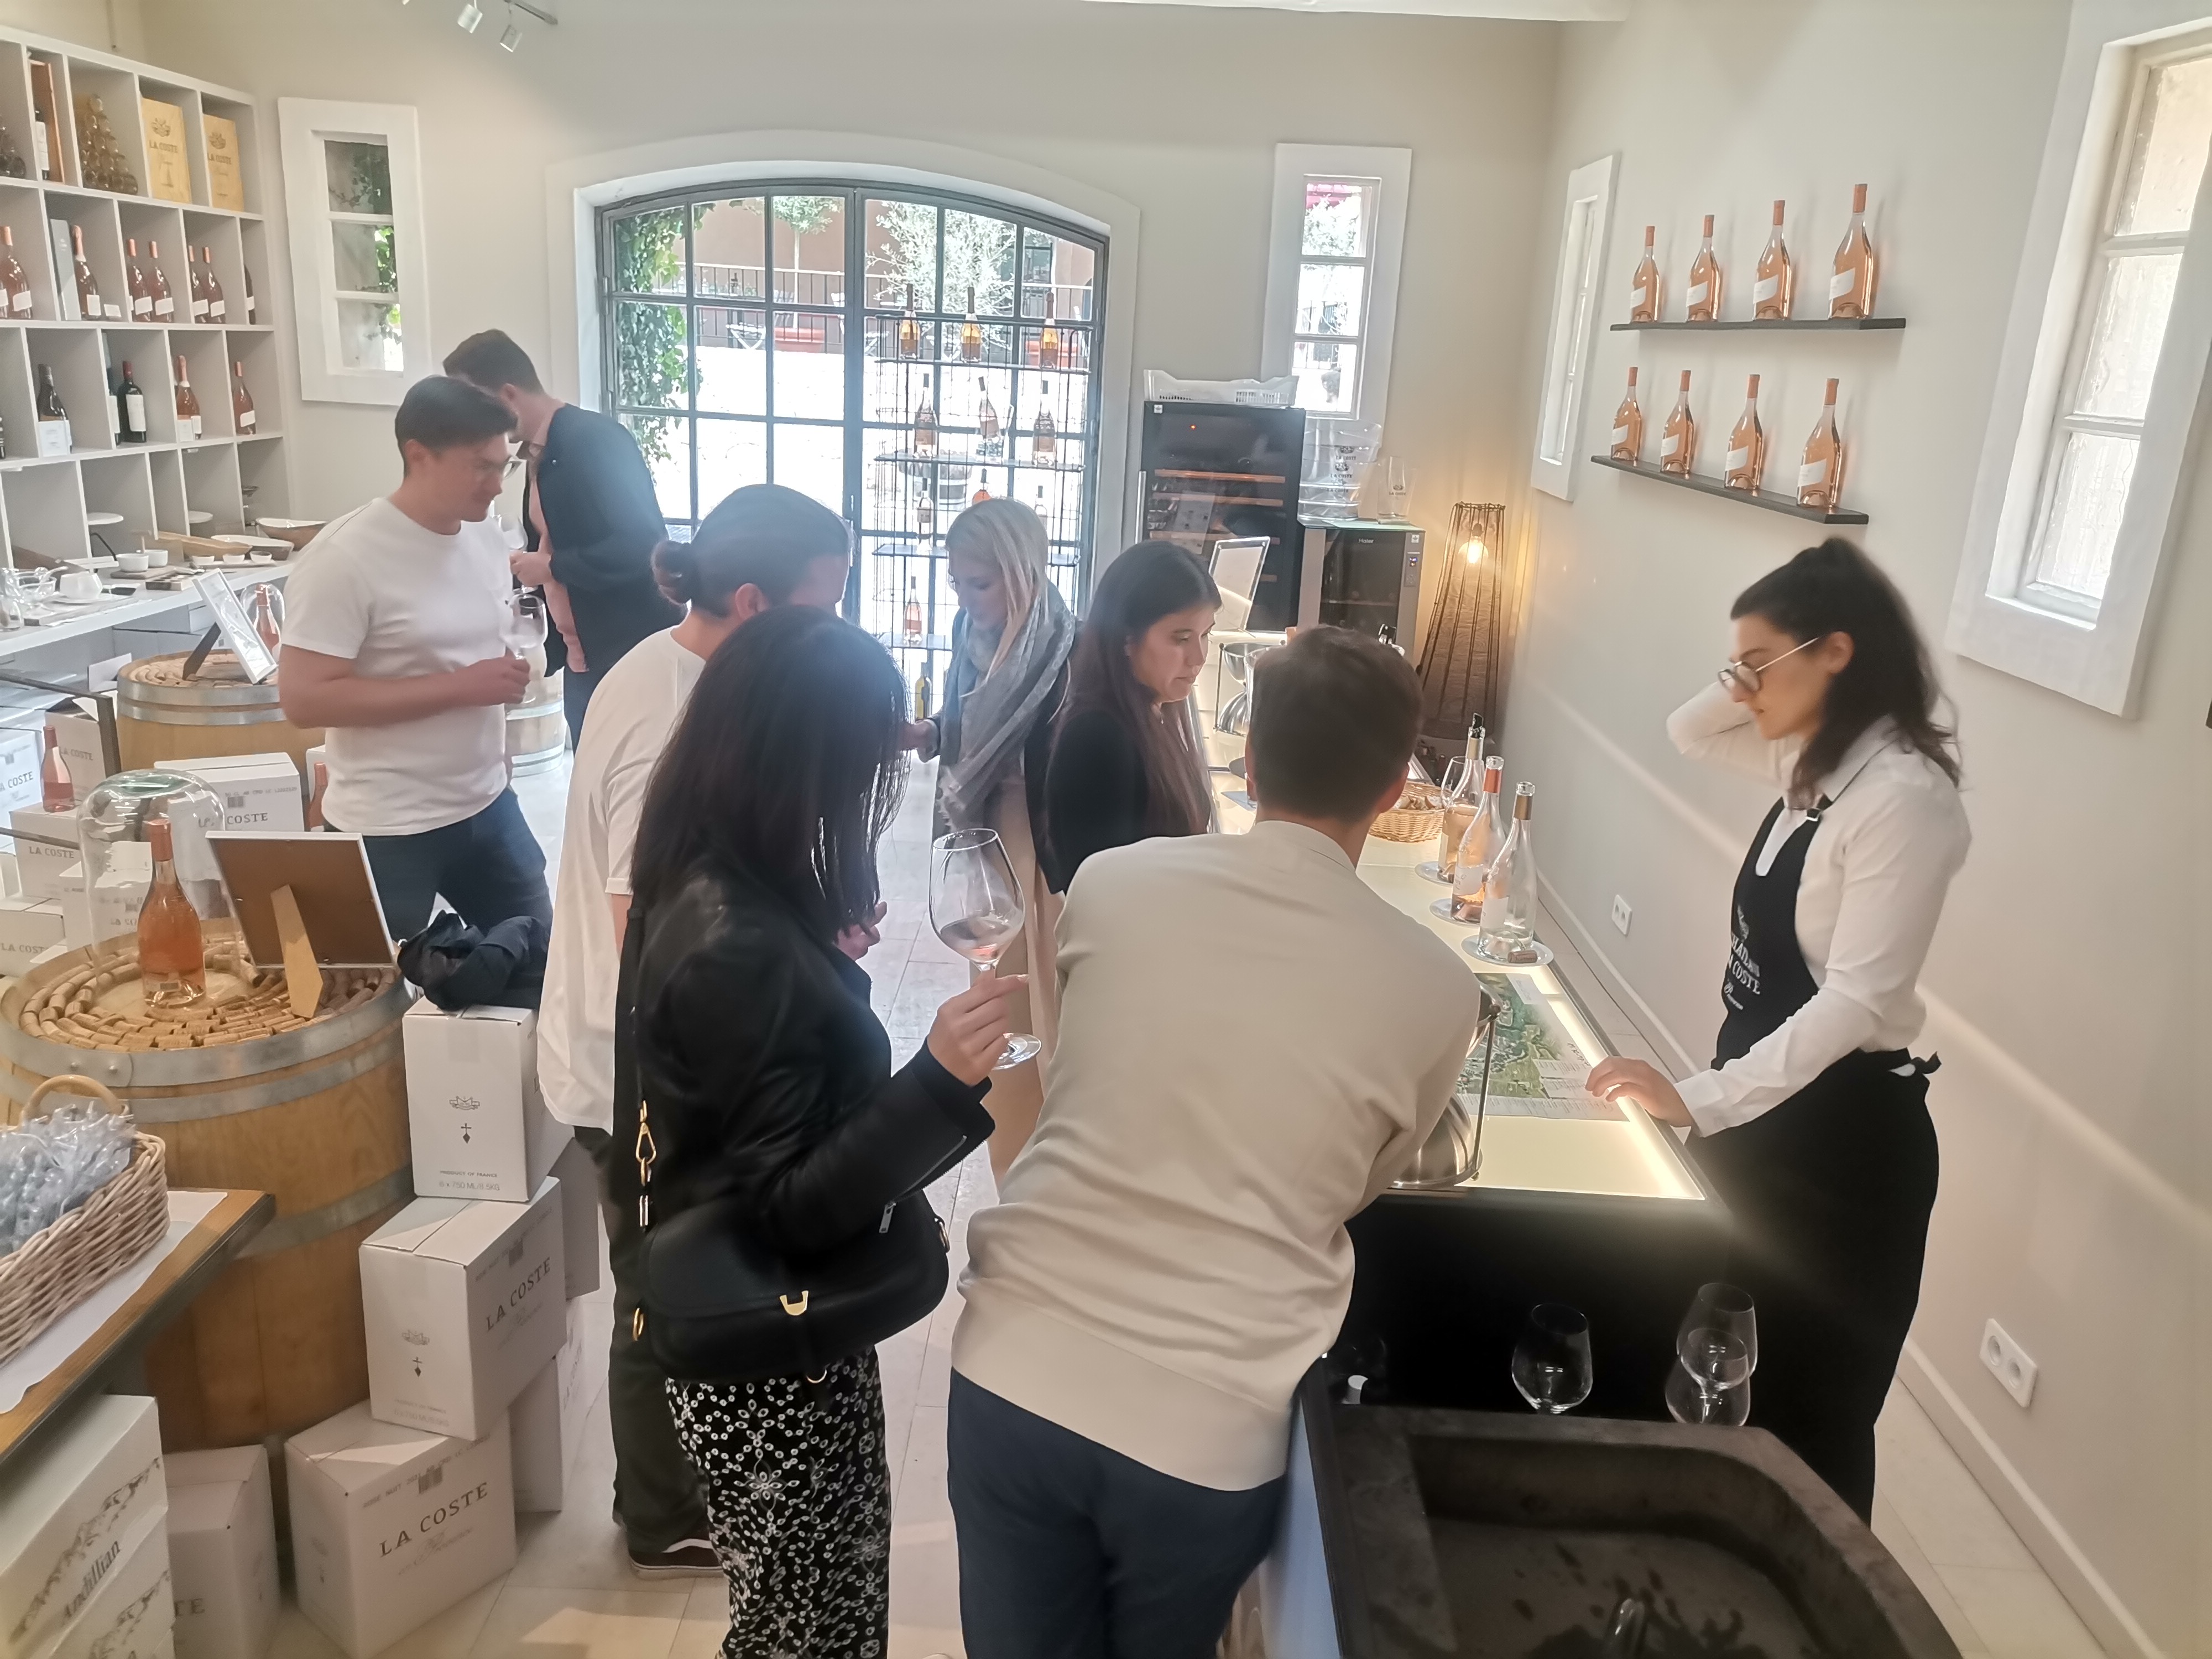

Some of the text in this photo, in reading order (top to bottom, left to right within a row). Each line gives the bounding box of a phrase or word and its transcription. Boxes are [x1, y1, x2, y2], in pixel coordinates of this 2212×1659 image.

[149, 140, 179, 154] LA COSTE
[207, 153, 215, 161] LA
[70, 748, 94, 761] COSTE
[7, 770, 34, 789] COSTE
[227, 812, 269, 825] COSTE
[28, 846, 75, 859] LA COSTE
[1, 943, 48, 954] LA COST
[1732, 961, 1761, 995] COSTE
[486, 1304, 506, 1332] LA
[510, 1256, 551, 1307] COSTE
[379, 1530, 413, 1558] LA
[420, 1481, 488, 1533] COSTE
